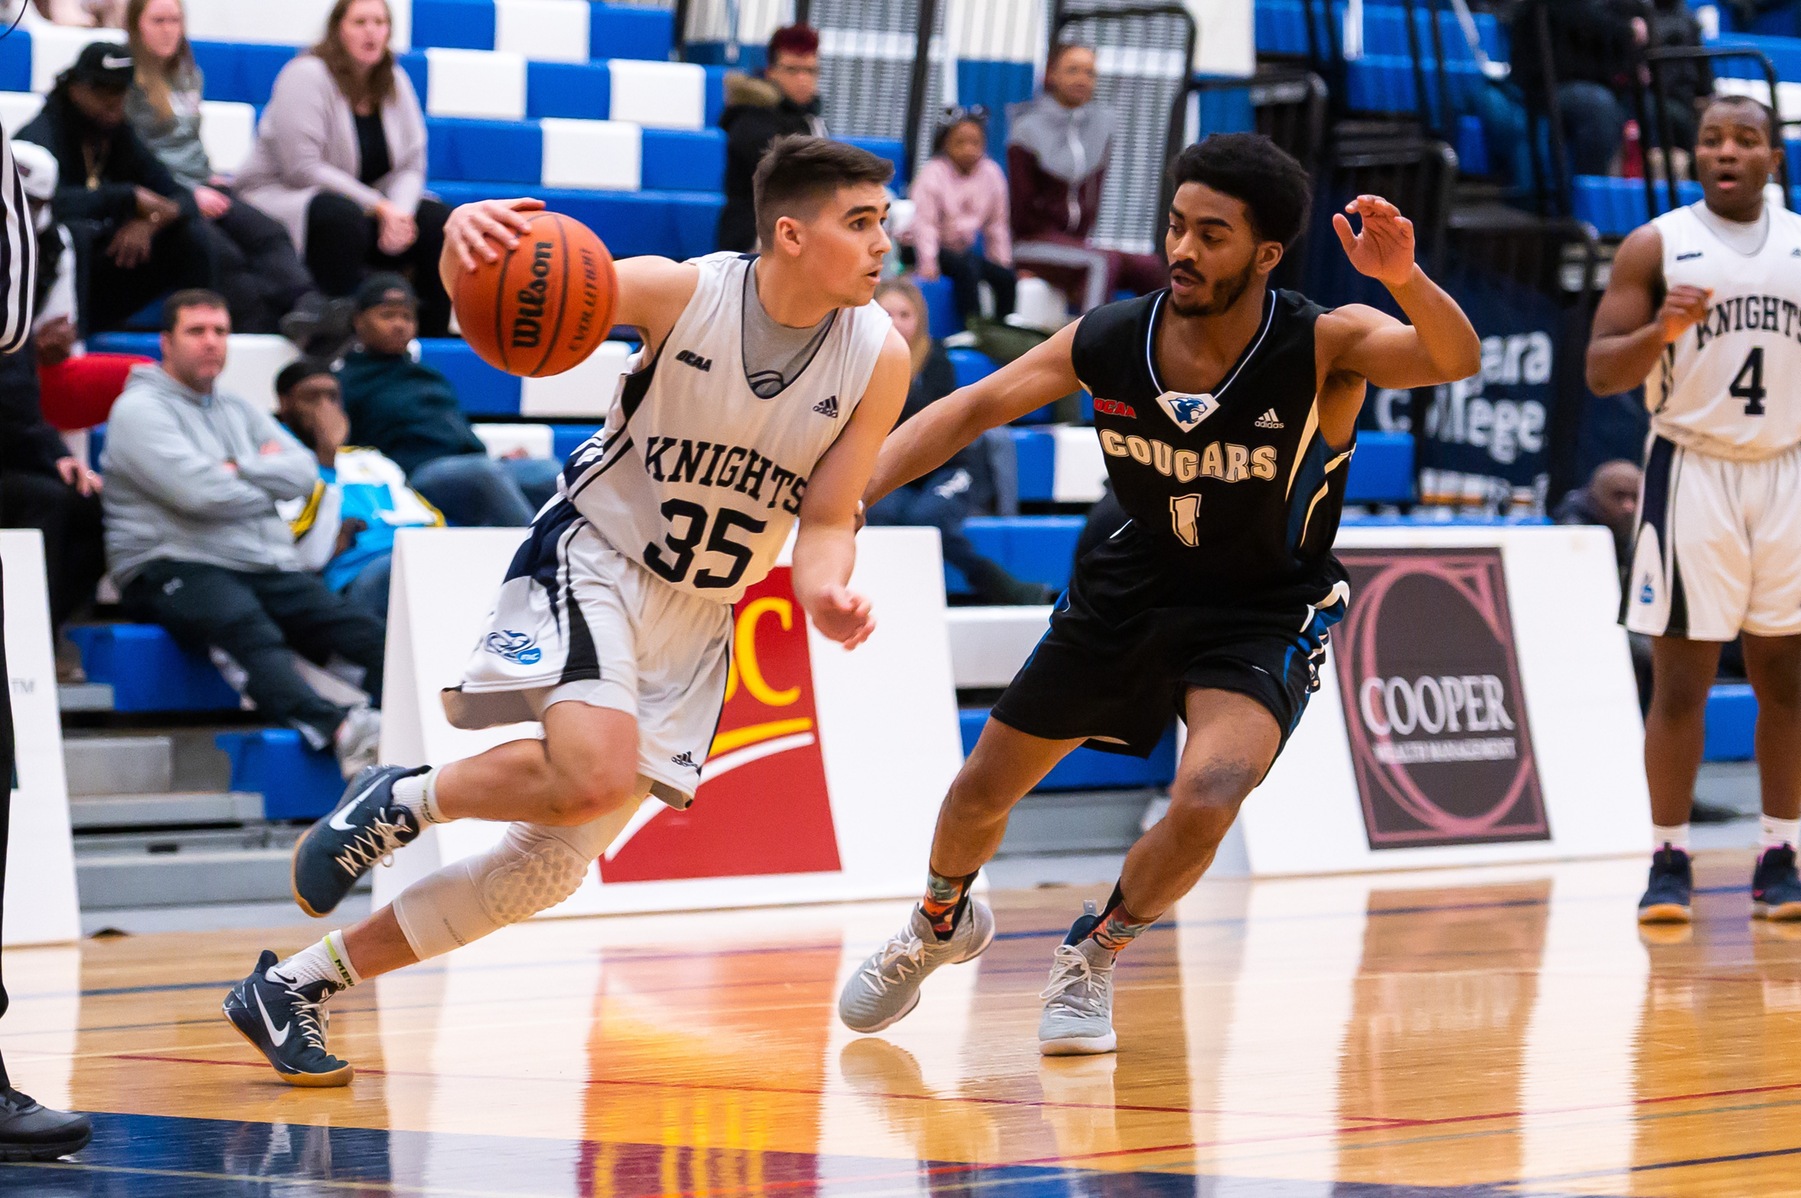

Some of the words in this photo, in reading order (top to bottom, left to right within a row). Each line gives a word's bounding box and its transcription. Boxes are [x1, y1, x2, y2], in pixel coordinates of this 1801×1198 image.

[512, 241, 554, 349] Wilson
[1696, 294, 1801, 350] KNIGHT
[1093, 397, 1137, 419] OCAA
[1729, 346, 1766, 415] 4
[1254, 420, 1284, 429] adidas
[645, 436, 808, 515] KNIGHTS
[1100, 429, 1277, 483] COUGARS
[643, 498, 767, 588] 35
[1169, 493, 1202, 547] 1
[1360, 675, 1515, 735] COOPER
